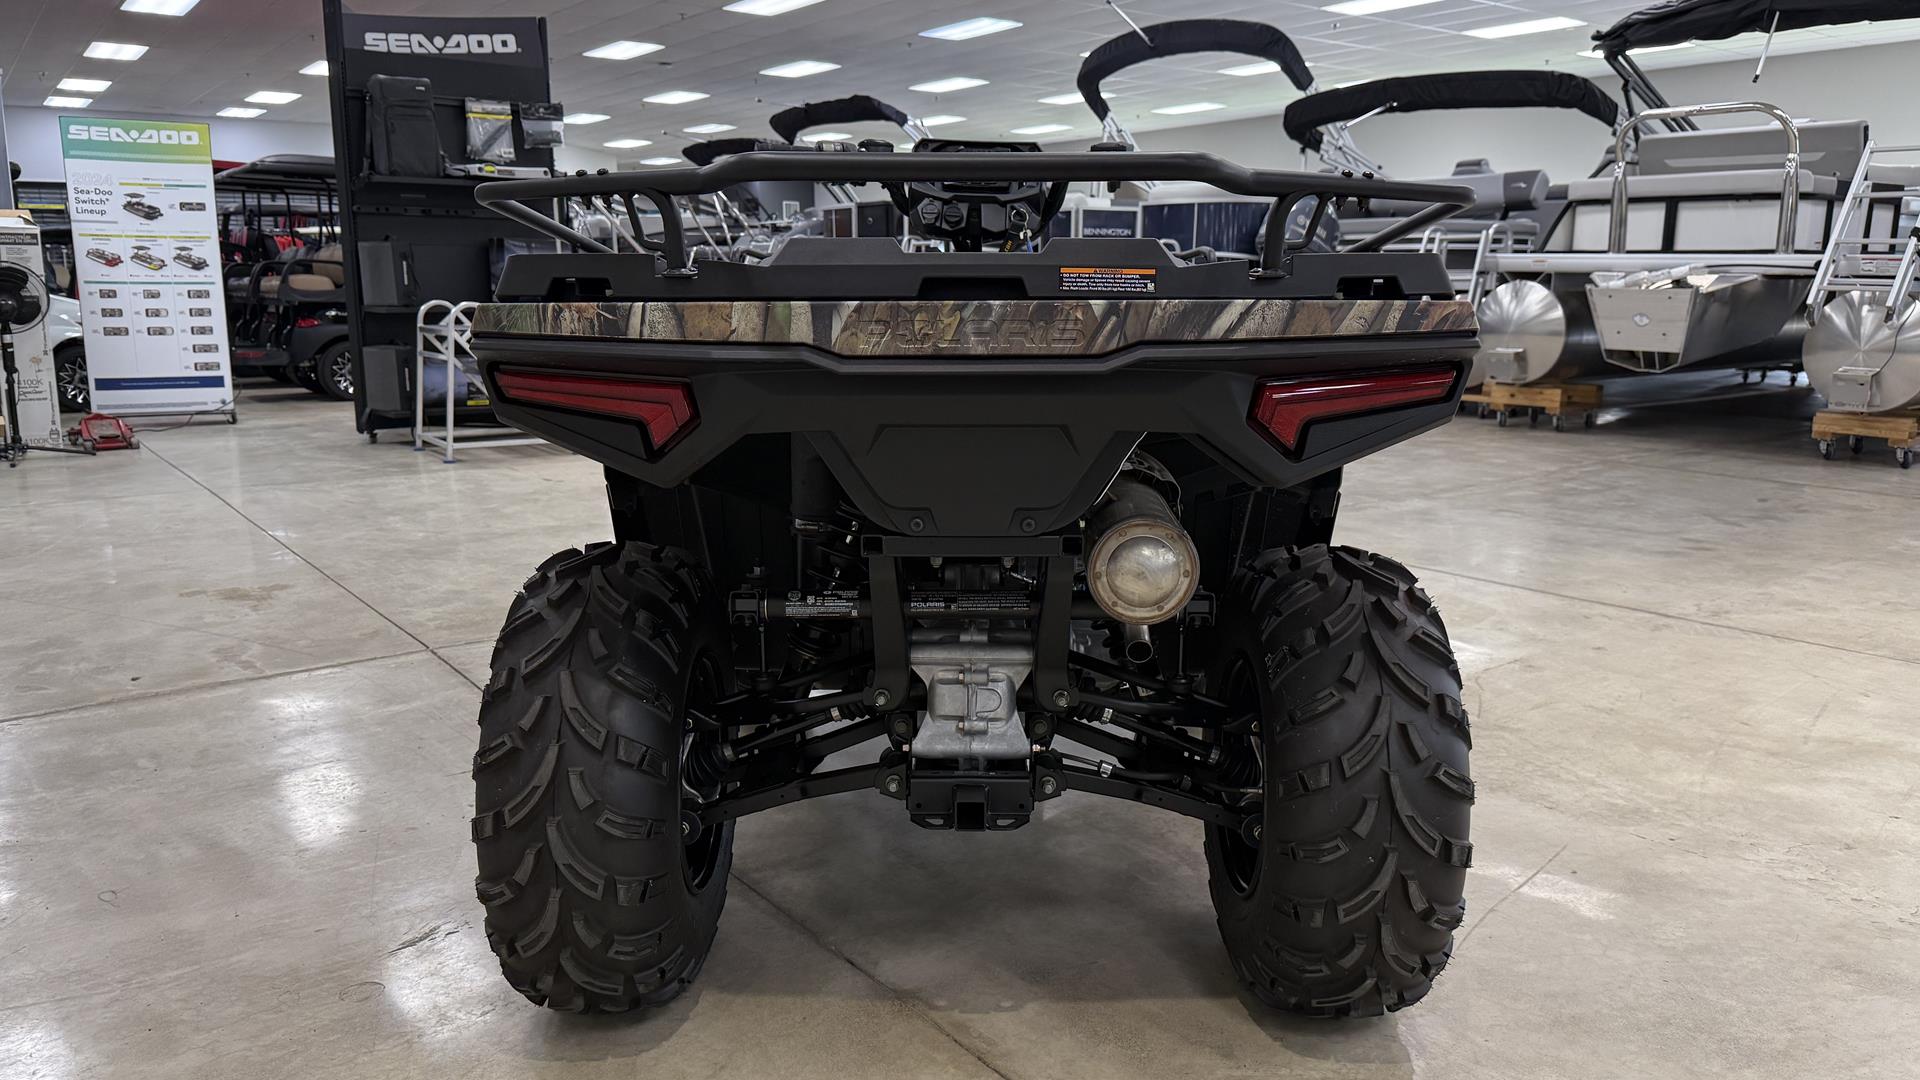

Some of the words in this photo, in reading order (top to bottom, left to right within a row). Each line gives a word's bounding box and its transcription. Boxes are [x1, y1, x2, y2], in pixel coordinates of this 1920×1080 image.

[74, 187, 112, 196] Sea-Doo
[76, 207, 106, 216] Lineup
[1083, 228, 1132, 236] BENNINGTON
